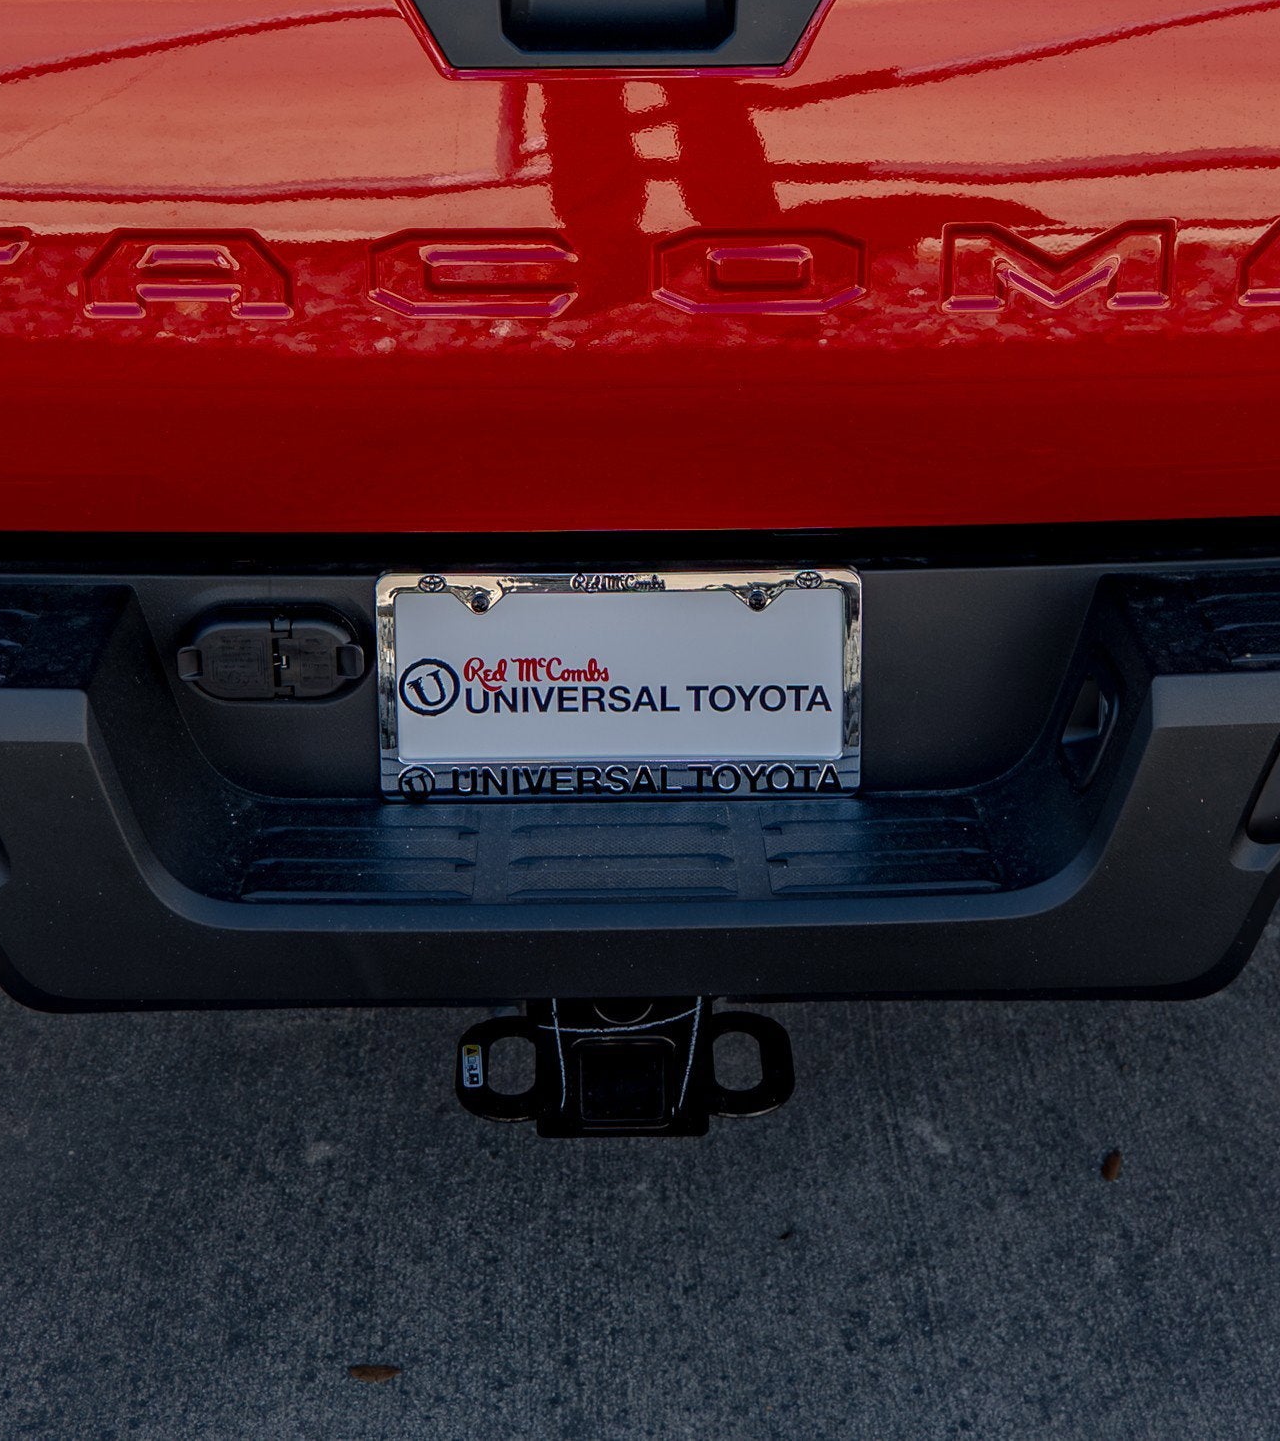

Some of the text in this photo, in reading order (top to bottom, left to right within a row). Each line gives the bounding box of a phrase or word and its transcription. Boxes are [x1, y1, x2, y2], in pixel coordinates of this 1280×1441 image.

[570, 572, 666, 593] Red McCombs
[463, 656, 610, 692] Red McCombs
[465, 684, 833, 714] UNIVERSAL TOYOTA
[450, 762, 843, 796] UNIVERSAL TOYOTA
